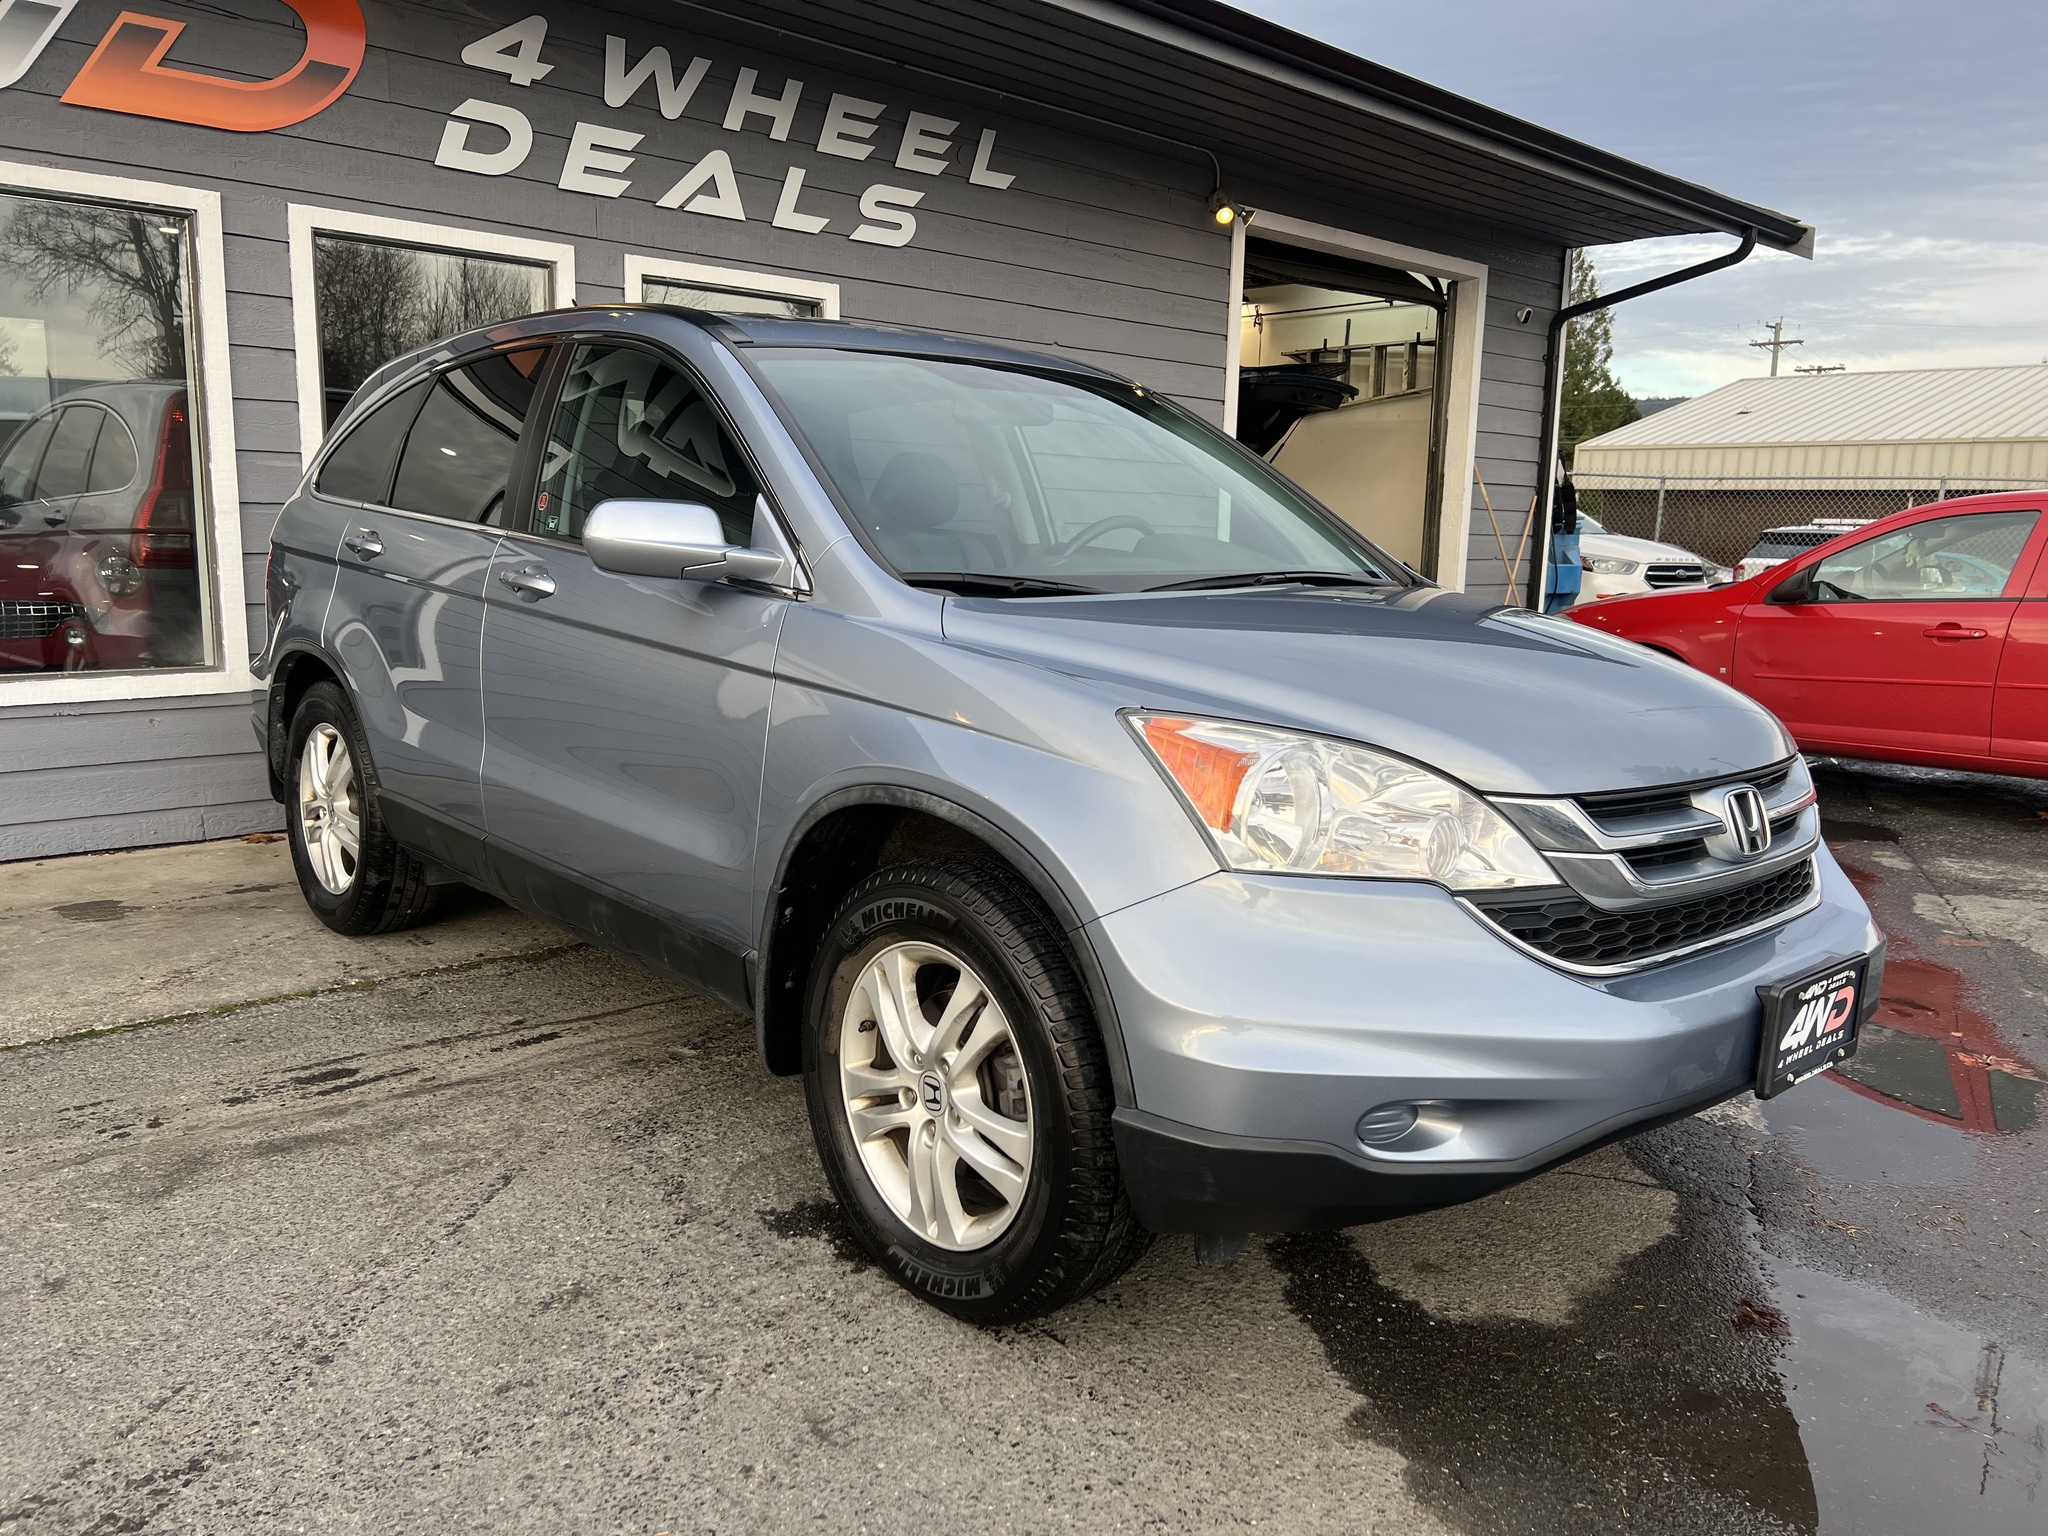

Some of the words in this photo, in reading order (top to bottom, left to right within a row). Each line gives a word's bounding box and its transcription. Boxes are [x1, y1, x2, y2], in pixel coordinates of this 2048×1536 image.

[460, 14, 556, 87] 4
[603, 33, 1017, 190] WHEEL
[433, 97, 926, 248] DEALS
[861, 901, 950, 931] MICHELIN
[1777, 1056, 1784, 1069] 4
[1786, 1044, 1814, 1066] WHEEL
[1816, 1029, 1845, 1049] DEALS
[1780, 985, 1855, 1051] 4WD
